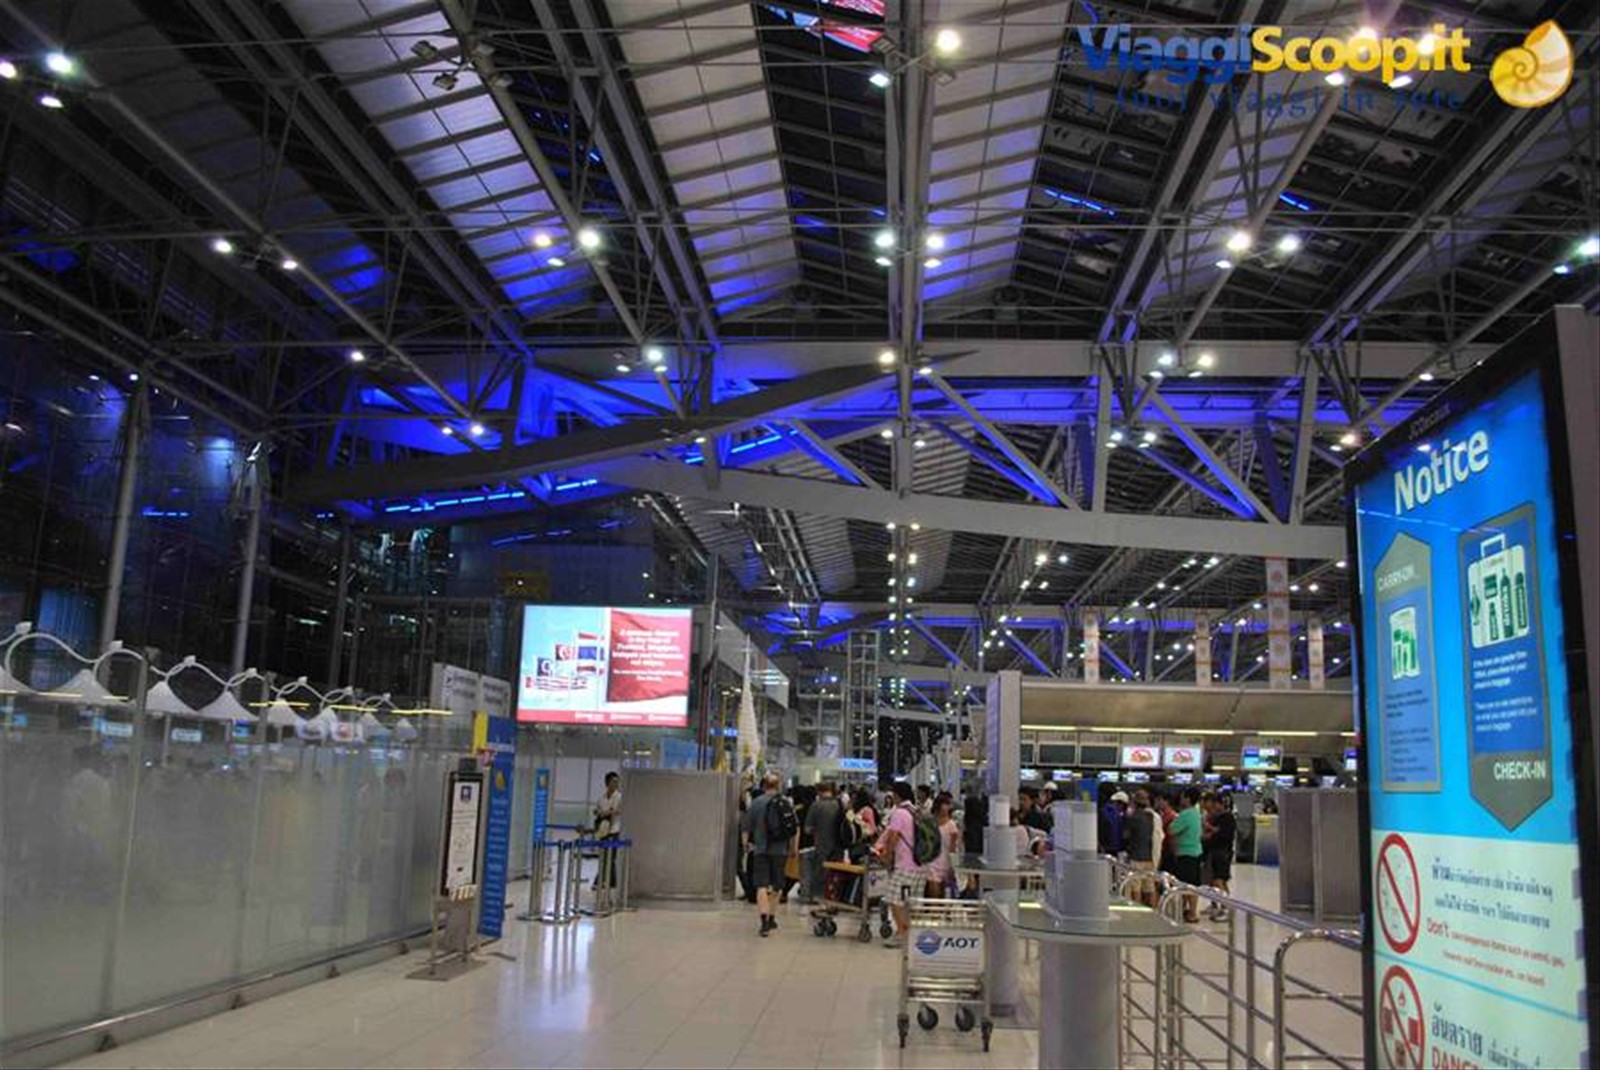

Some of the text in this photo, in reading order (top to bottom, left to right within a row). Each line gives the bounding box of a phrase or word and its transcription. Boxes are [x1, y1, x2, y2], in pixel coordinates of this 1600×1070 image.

[1394, 430, 1490, 516] Notice
[1493, 760, 1547, 782] CHECK-IN
[943, 937, 979, 949] AOT
